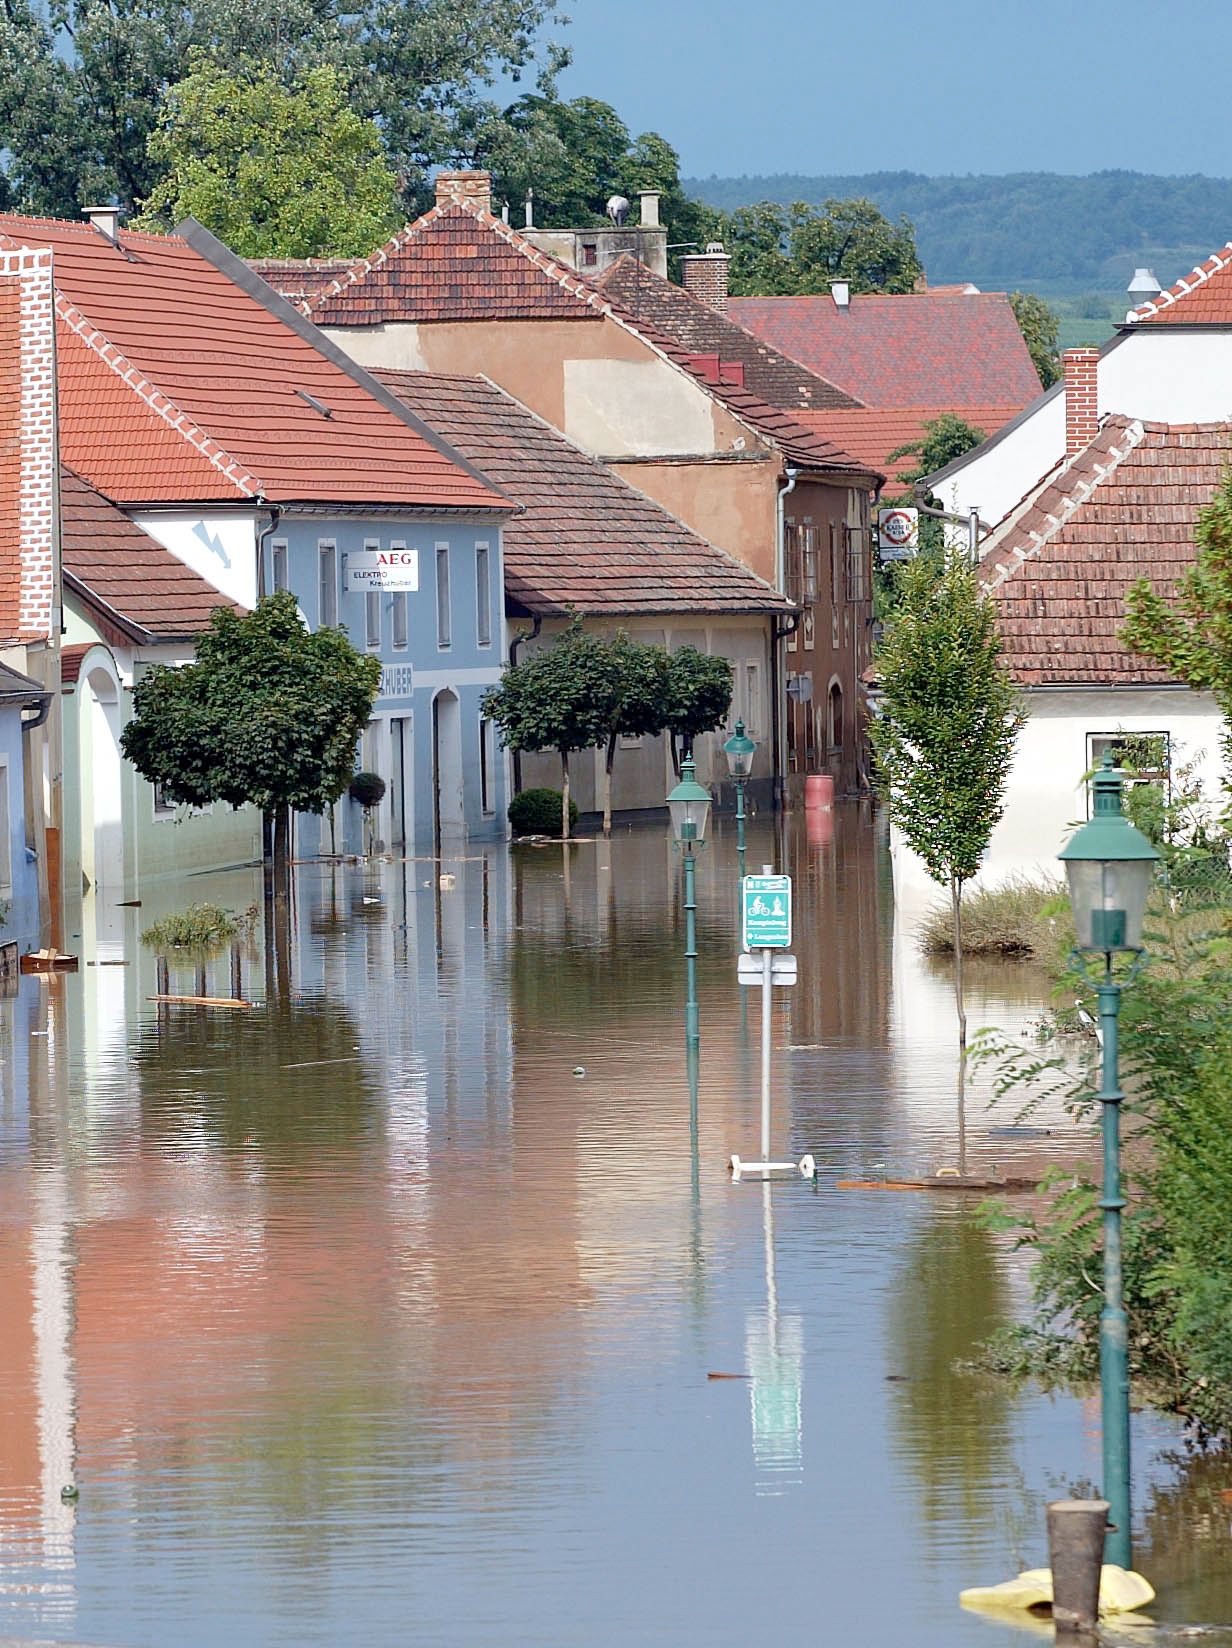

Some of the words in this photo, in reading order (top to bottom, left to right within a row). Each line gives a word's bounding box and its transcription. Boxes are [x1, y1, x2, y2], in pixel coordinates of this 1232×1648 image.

[376, 553, 412, 565] AEG
[354, 571, 388, 579] ELEKTRO
[380, 667, 413, 696] ZHUBER
